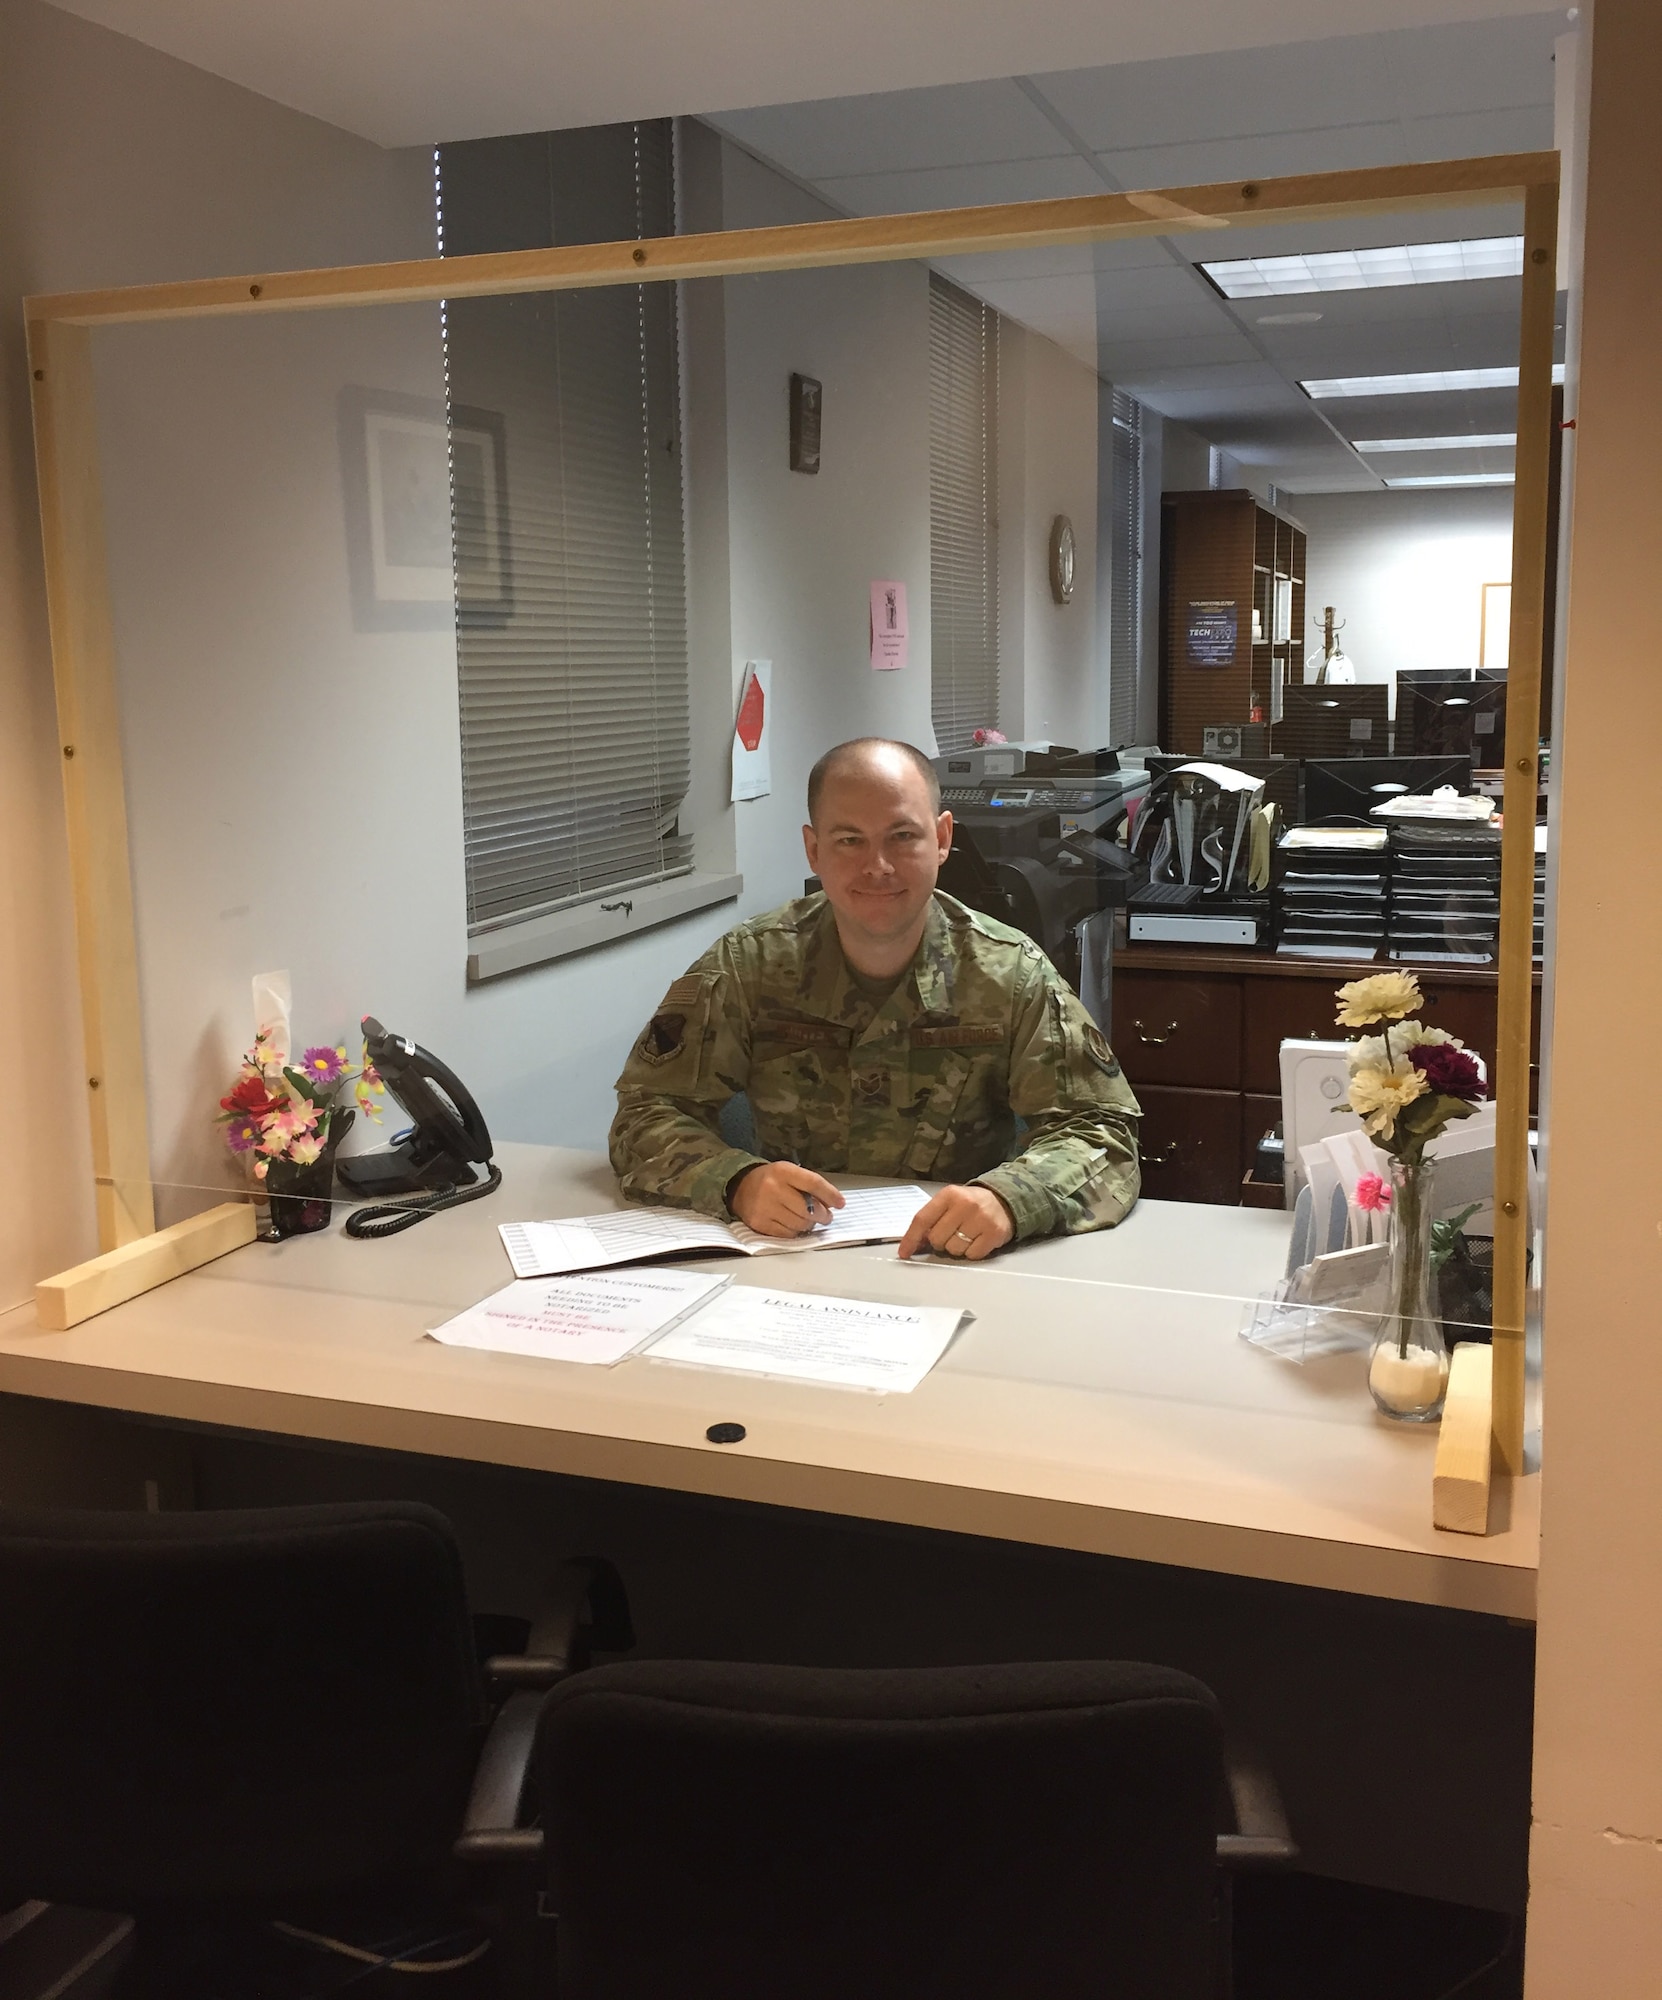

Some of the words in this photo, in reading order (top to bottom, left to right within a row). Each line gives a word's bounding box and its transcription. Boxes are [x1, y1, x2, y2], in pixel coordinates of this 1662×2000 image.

[1189, 629, 1211, 637] TECH
[961, 1026, 999, 1044] FORCE
[544, 1295, 594, 1305] NEEDING
[575, 1290, 641, 1303] DOCUMENTS
[544, 1302, 611, 1314] NOTARIZED
[761, 1298, 814, 1310] LEGAL
[536, 1326, 585, 1337] NOTARY
